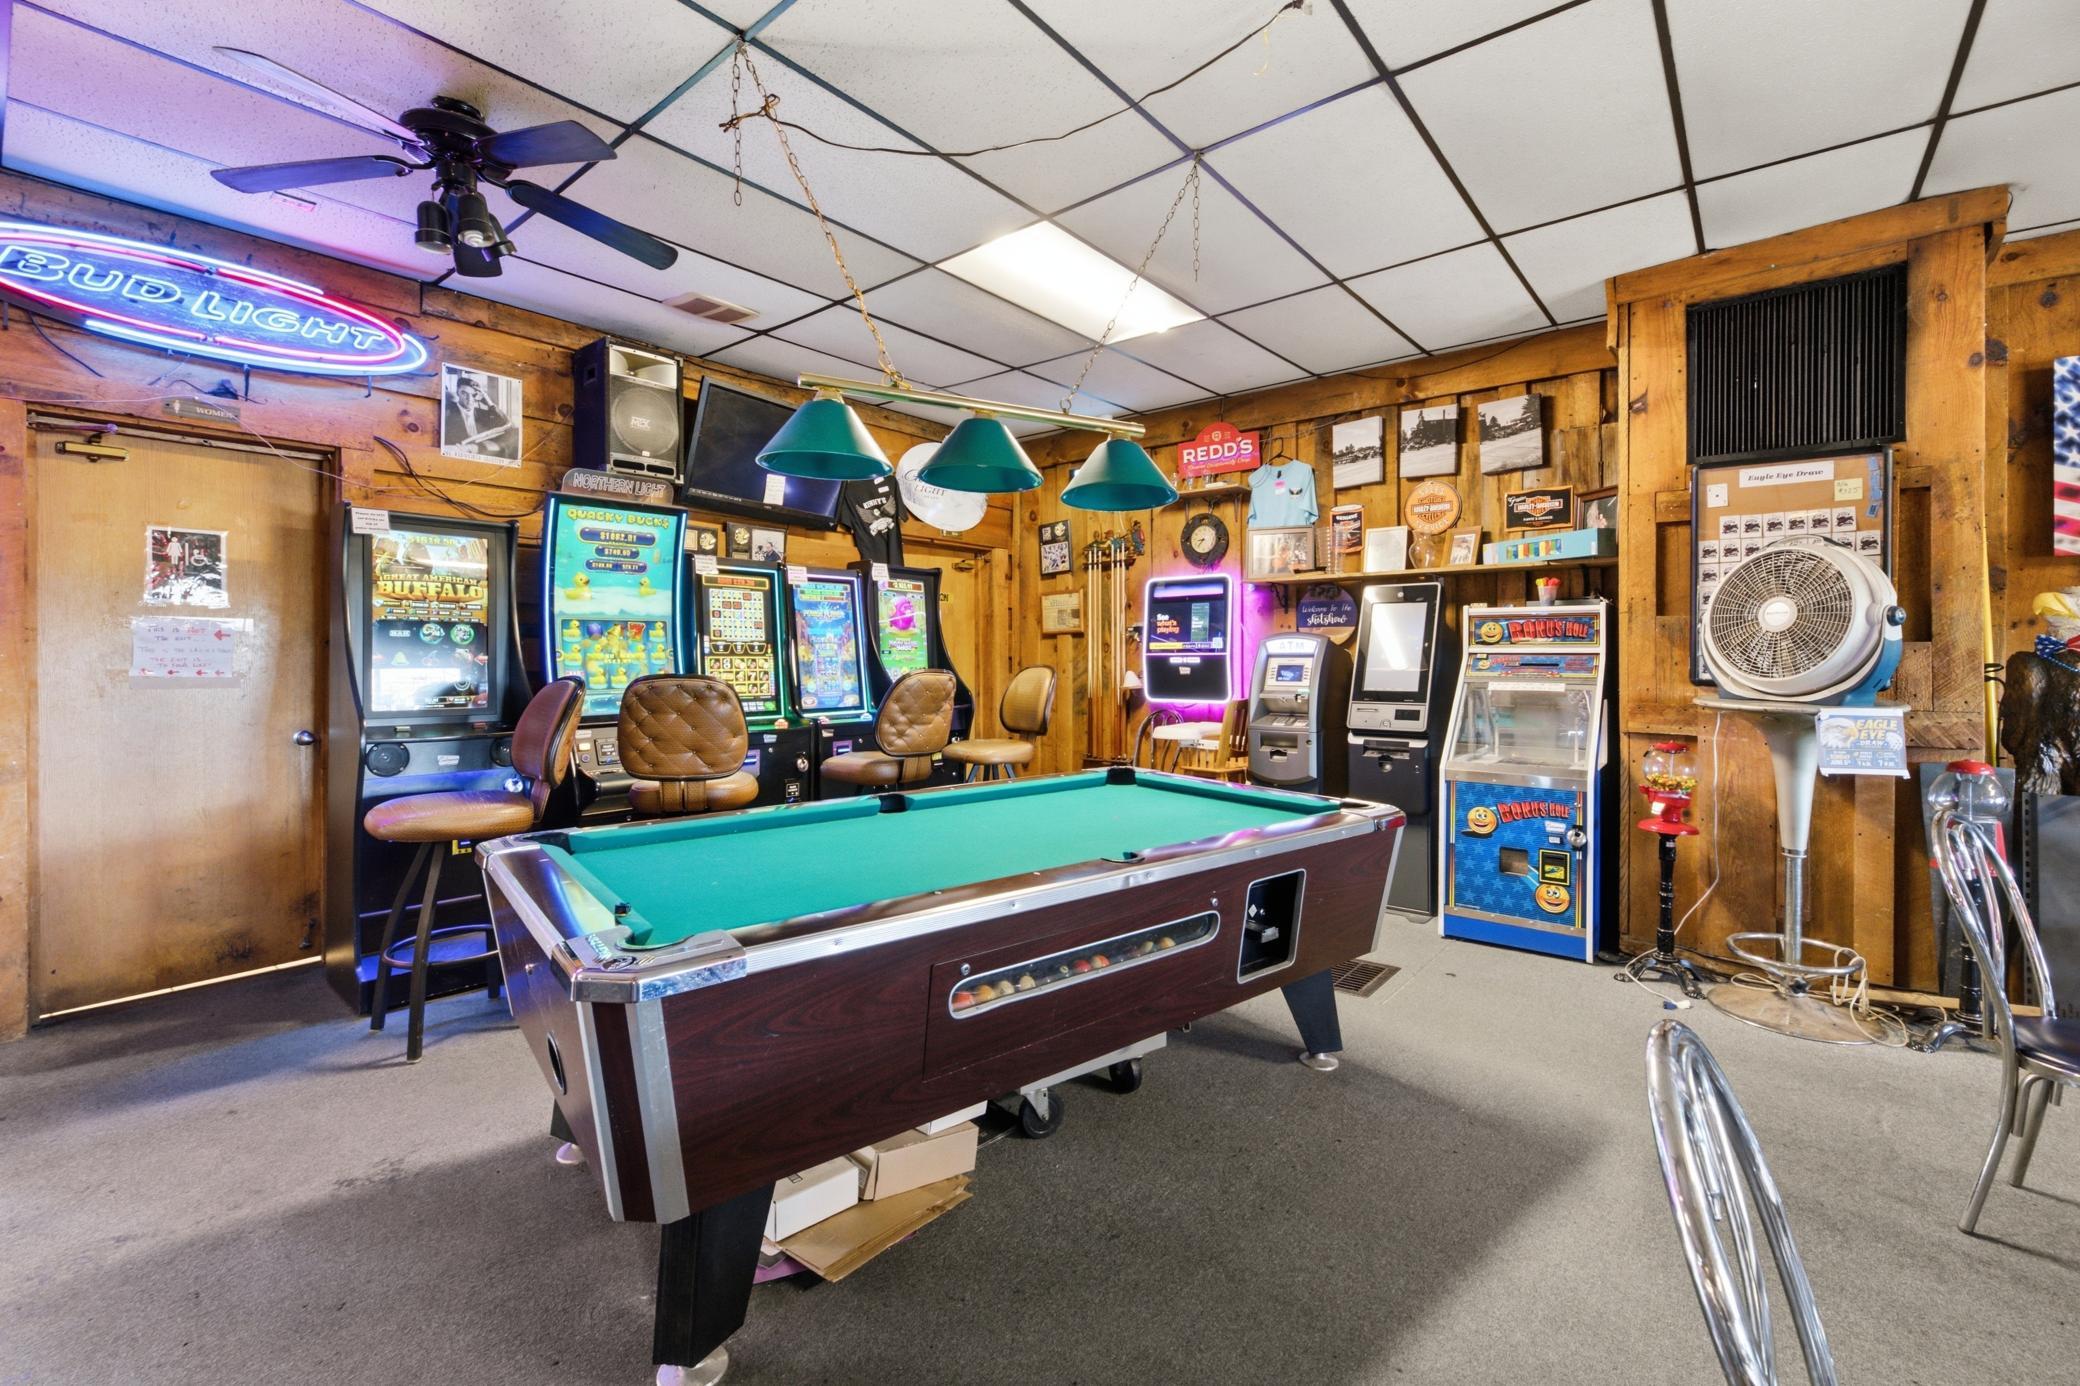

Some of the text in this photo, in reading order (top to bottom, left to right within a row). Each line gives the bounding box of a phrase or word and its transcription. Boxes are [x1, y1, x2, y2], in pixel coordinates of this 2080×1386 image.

[0, 245, 387, 350] BUD LIGHT
[1182, 437, 1253, 463] REDD'S
[1748, 469, 1824, 482] Eagle Eye Draw
[573, 472, 634, 495] NORTHERN
[634, 480, 666, 498] LIGHT
[567, 508, 623, 524] QUACKY
[377, 581, 484, 599] BUFFALO
[1508, 619, 1589, 643] BONUS HOLE
[1279, 641, 1305, 650] ATM
[1856, 719, 1898, 730] EAGLE
[1860, 729, 1887, 740] EYE
[1497, 800, 1570, 823] BONUS HOLE
